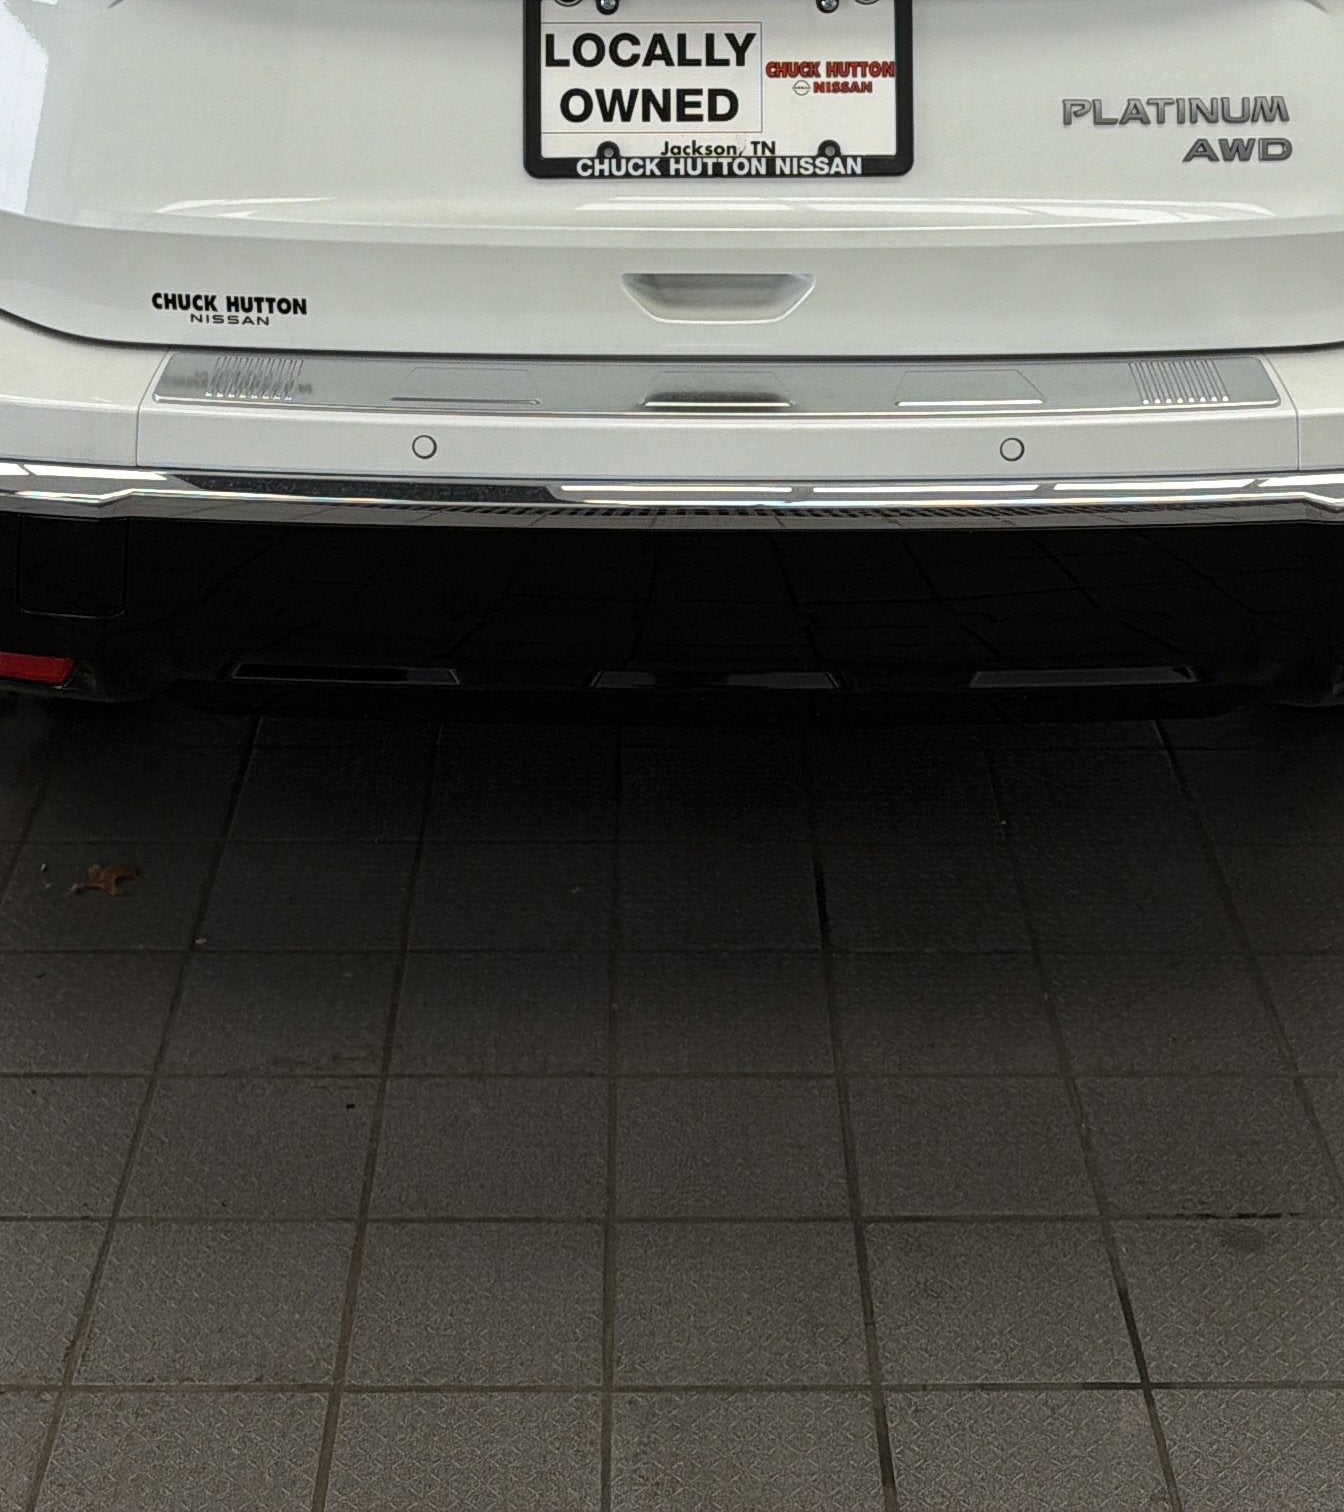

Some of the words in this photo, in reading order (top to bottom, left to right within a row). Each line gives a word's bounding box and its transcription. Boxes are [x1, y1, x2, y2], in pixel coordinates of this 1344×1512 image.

[544, 32, 757, 68] LOCALLY
[765, 61, 821, 78] CHUCK
[825, 61, 896, 78] HUTTON
[813, 82, 873, 94] NISSAN
[560, 87, 739, 123] OWNED
[1062, 96, 1290, 126] PLATINUM
[660, 140, 744, 158] Jackson,
[750, 141, 776, 156] TN
[1182, 138, 1293, 162] AWD
[576, 158, 661, 177] CHUCK
[669, 157, 768, 176] HUTTON
[774, 156, 863, 175] NISSAN
[151, 292, 218, 312] CHUCK
[226, 296, 308, 315] HUTTON
[190, 314, 269, 326] NISSAN
